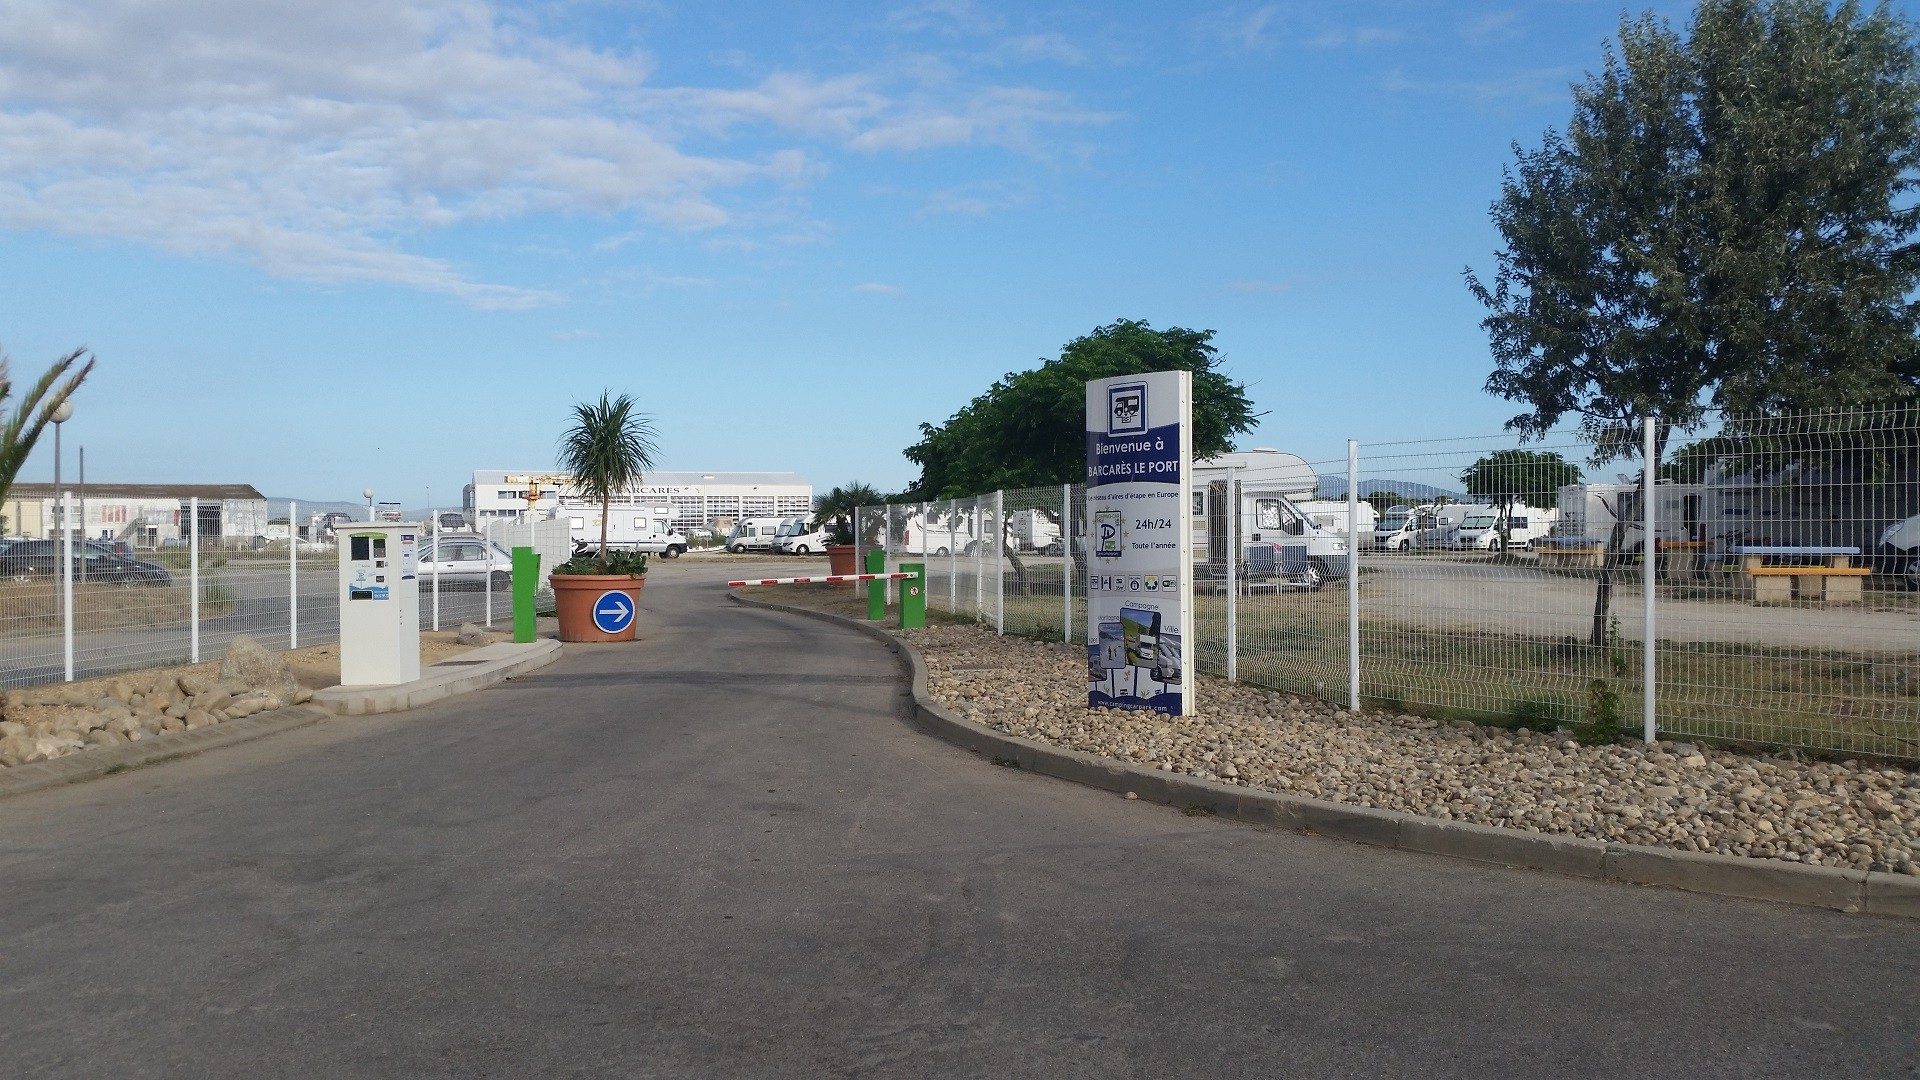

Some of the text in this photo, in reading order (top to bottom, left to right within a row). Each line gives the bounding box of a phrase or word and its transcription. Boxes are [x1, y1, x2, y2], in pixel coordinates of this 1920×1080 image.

[1096, 437, 1164, 455] Bienvenue à
[1088, 461, 1179, 477] BARCARÈS LE PORT
[1156, 491, 1179, 499] Europe
[1135, 518, 1172, 530] 24h/24
[1150, 541, 1176, 549] l'année
[1125, 600, 1159, 611] Campagne
[1164, 625, 1179, 634] Ville
